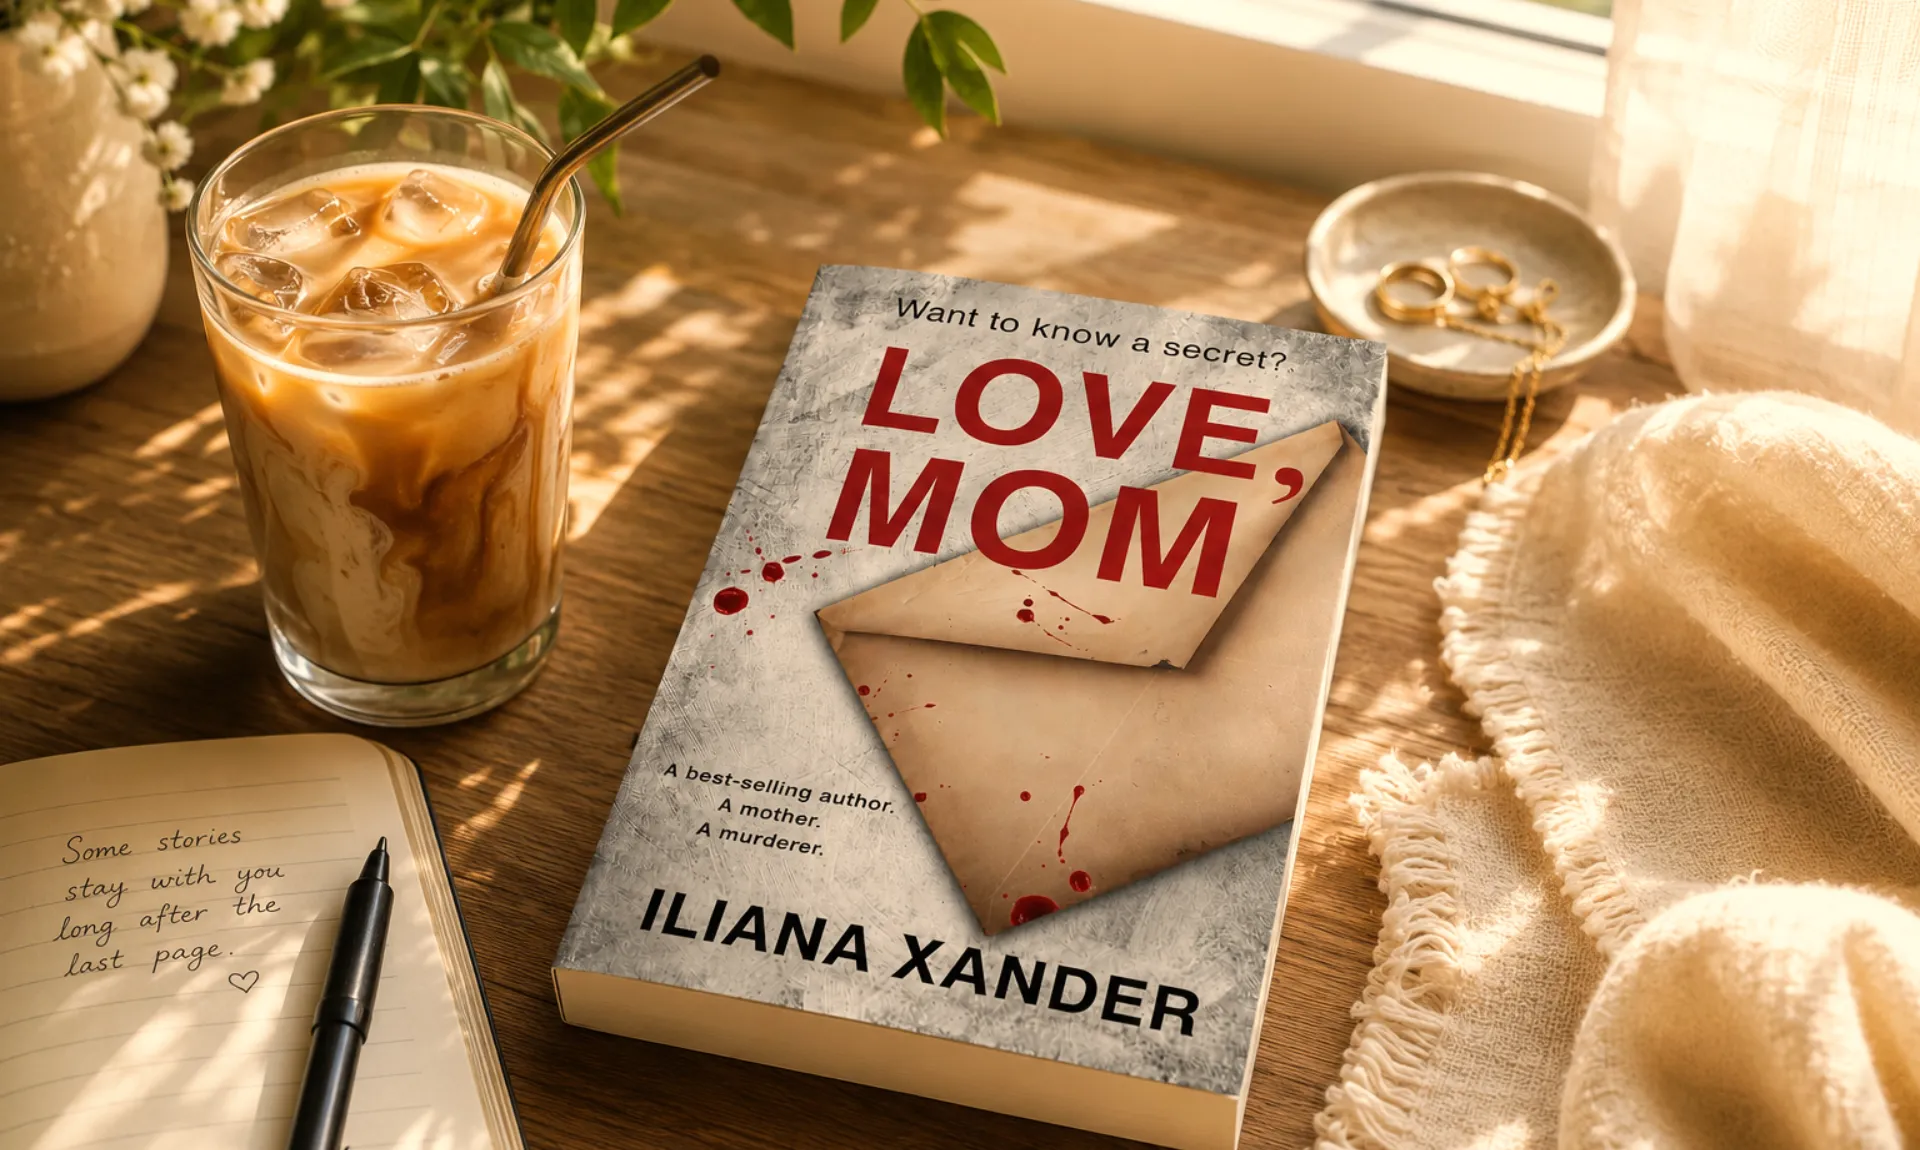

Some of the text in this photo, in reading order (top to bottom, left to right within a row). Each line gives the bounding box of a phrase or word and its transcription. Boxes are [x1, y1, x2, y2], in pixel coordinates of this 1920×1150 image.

[897, 298, 1288, 372] Want to know a secret?
[861, 346, 1305, 504] LOVE,
[826, 448, 1238, 598] MOM
[664, 763, 896, 815] A best-selling author.
[718, 798, 821, 828] A mother.
[62, 828, 242, 865] Some stories
[696, 822, 824, 857] A murderer.
[65, 865, 285, 909] stay with you
[53, 893, 281, 947] long after the
[64, 940, 234, 977] last page.
[640, 888, 1200, 1037] ILIANA XANDER
